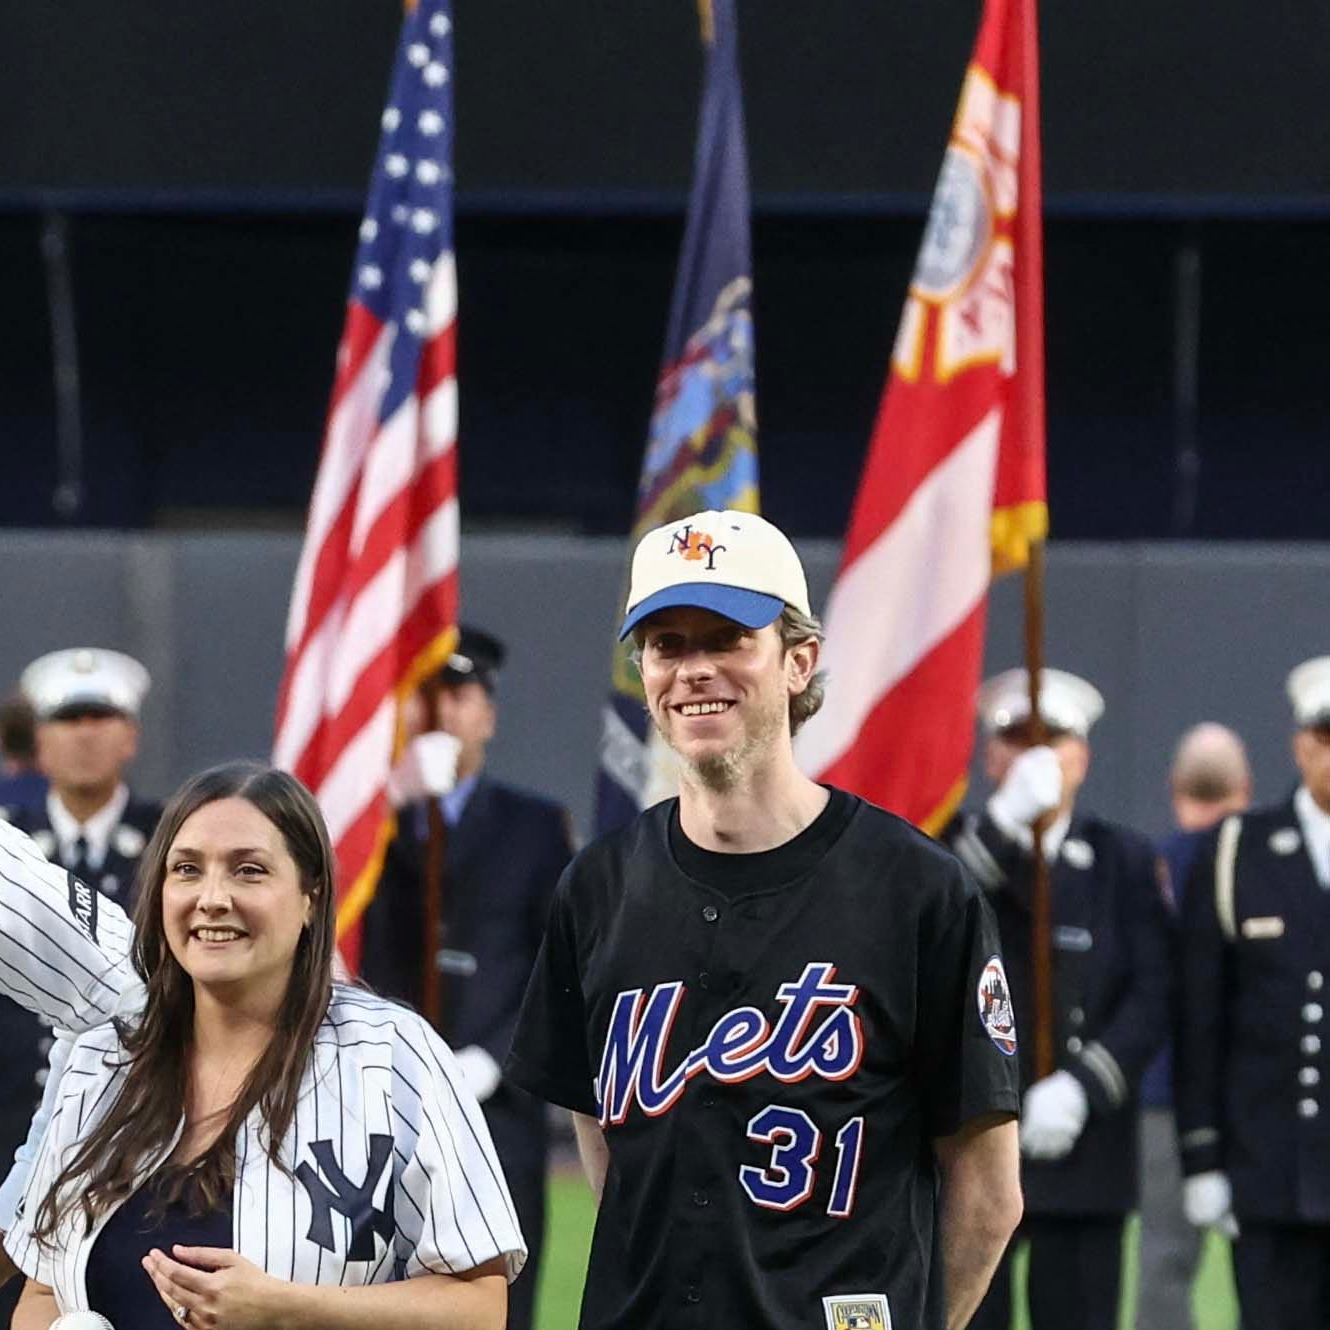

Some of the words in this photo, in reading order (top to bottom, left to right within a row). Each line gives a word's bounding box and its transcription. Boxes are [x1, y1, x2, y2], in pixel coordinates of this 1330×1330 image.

[667, 524, 727, 571] NY
[593, 962, 865, 1128] Mets
[293, 1132, 395, 1262] NY
[739, 1104, 864, 1220] 31
